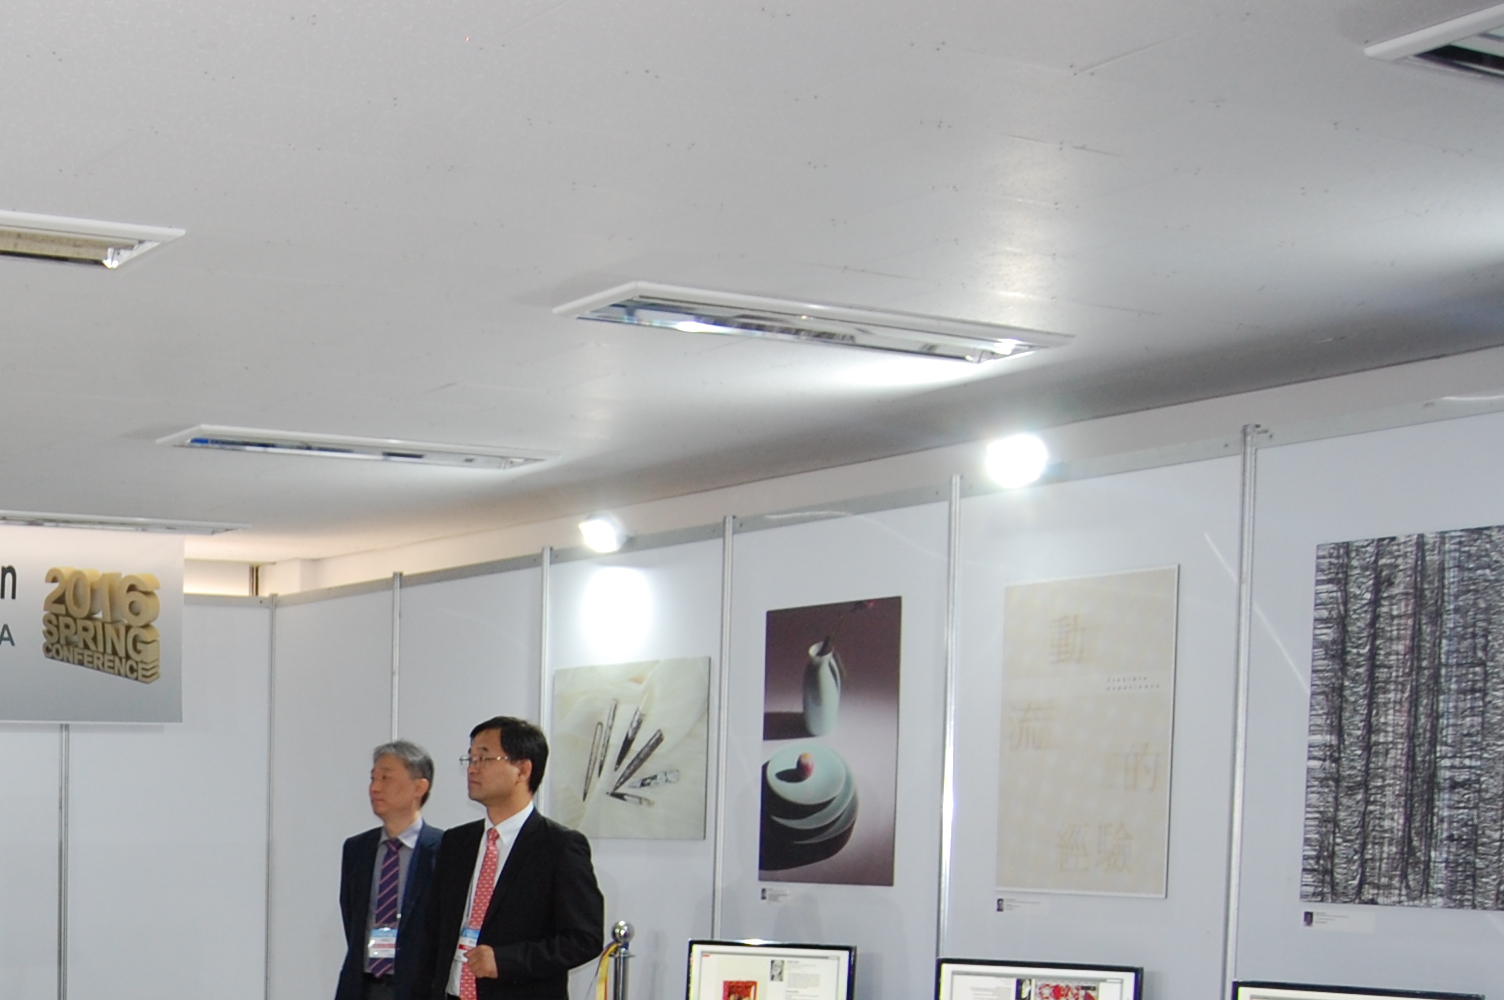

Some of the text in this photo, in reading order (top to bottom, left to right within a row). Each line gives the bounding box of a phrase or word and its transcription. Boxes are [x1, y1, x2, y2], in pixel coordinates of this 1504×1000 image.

[43, 566, 160, 627] 2016
[42, 612, 160, 662] SPRING
[42, 641, 160, 684] CONFERENCE
